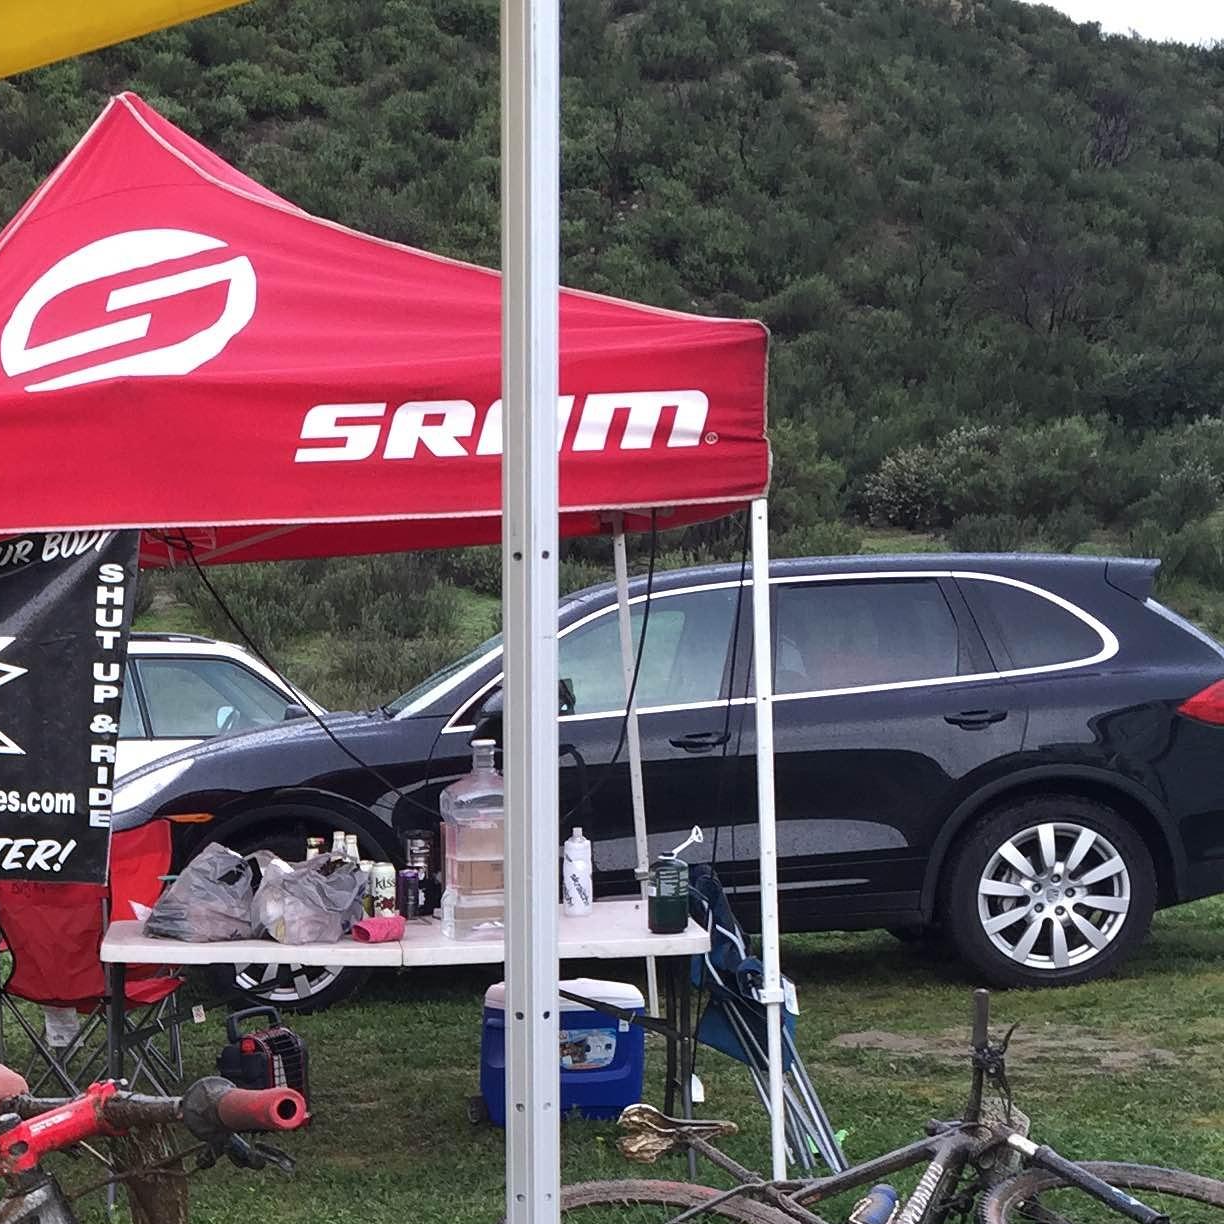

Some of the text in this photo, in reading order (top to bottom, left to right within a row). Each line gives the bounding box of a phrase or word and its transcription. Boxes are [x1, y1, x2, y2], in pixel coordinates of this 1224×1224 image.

[88, 563, 125, 829] SHUT UP & RIDE
